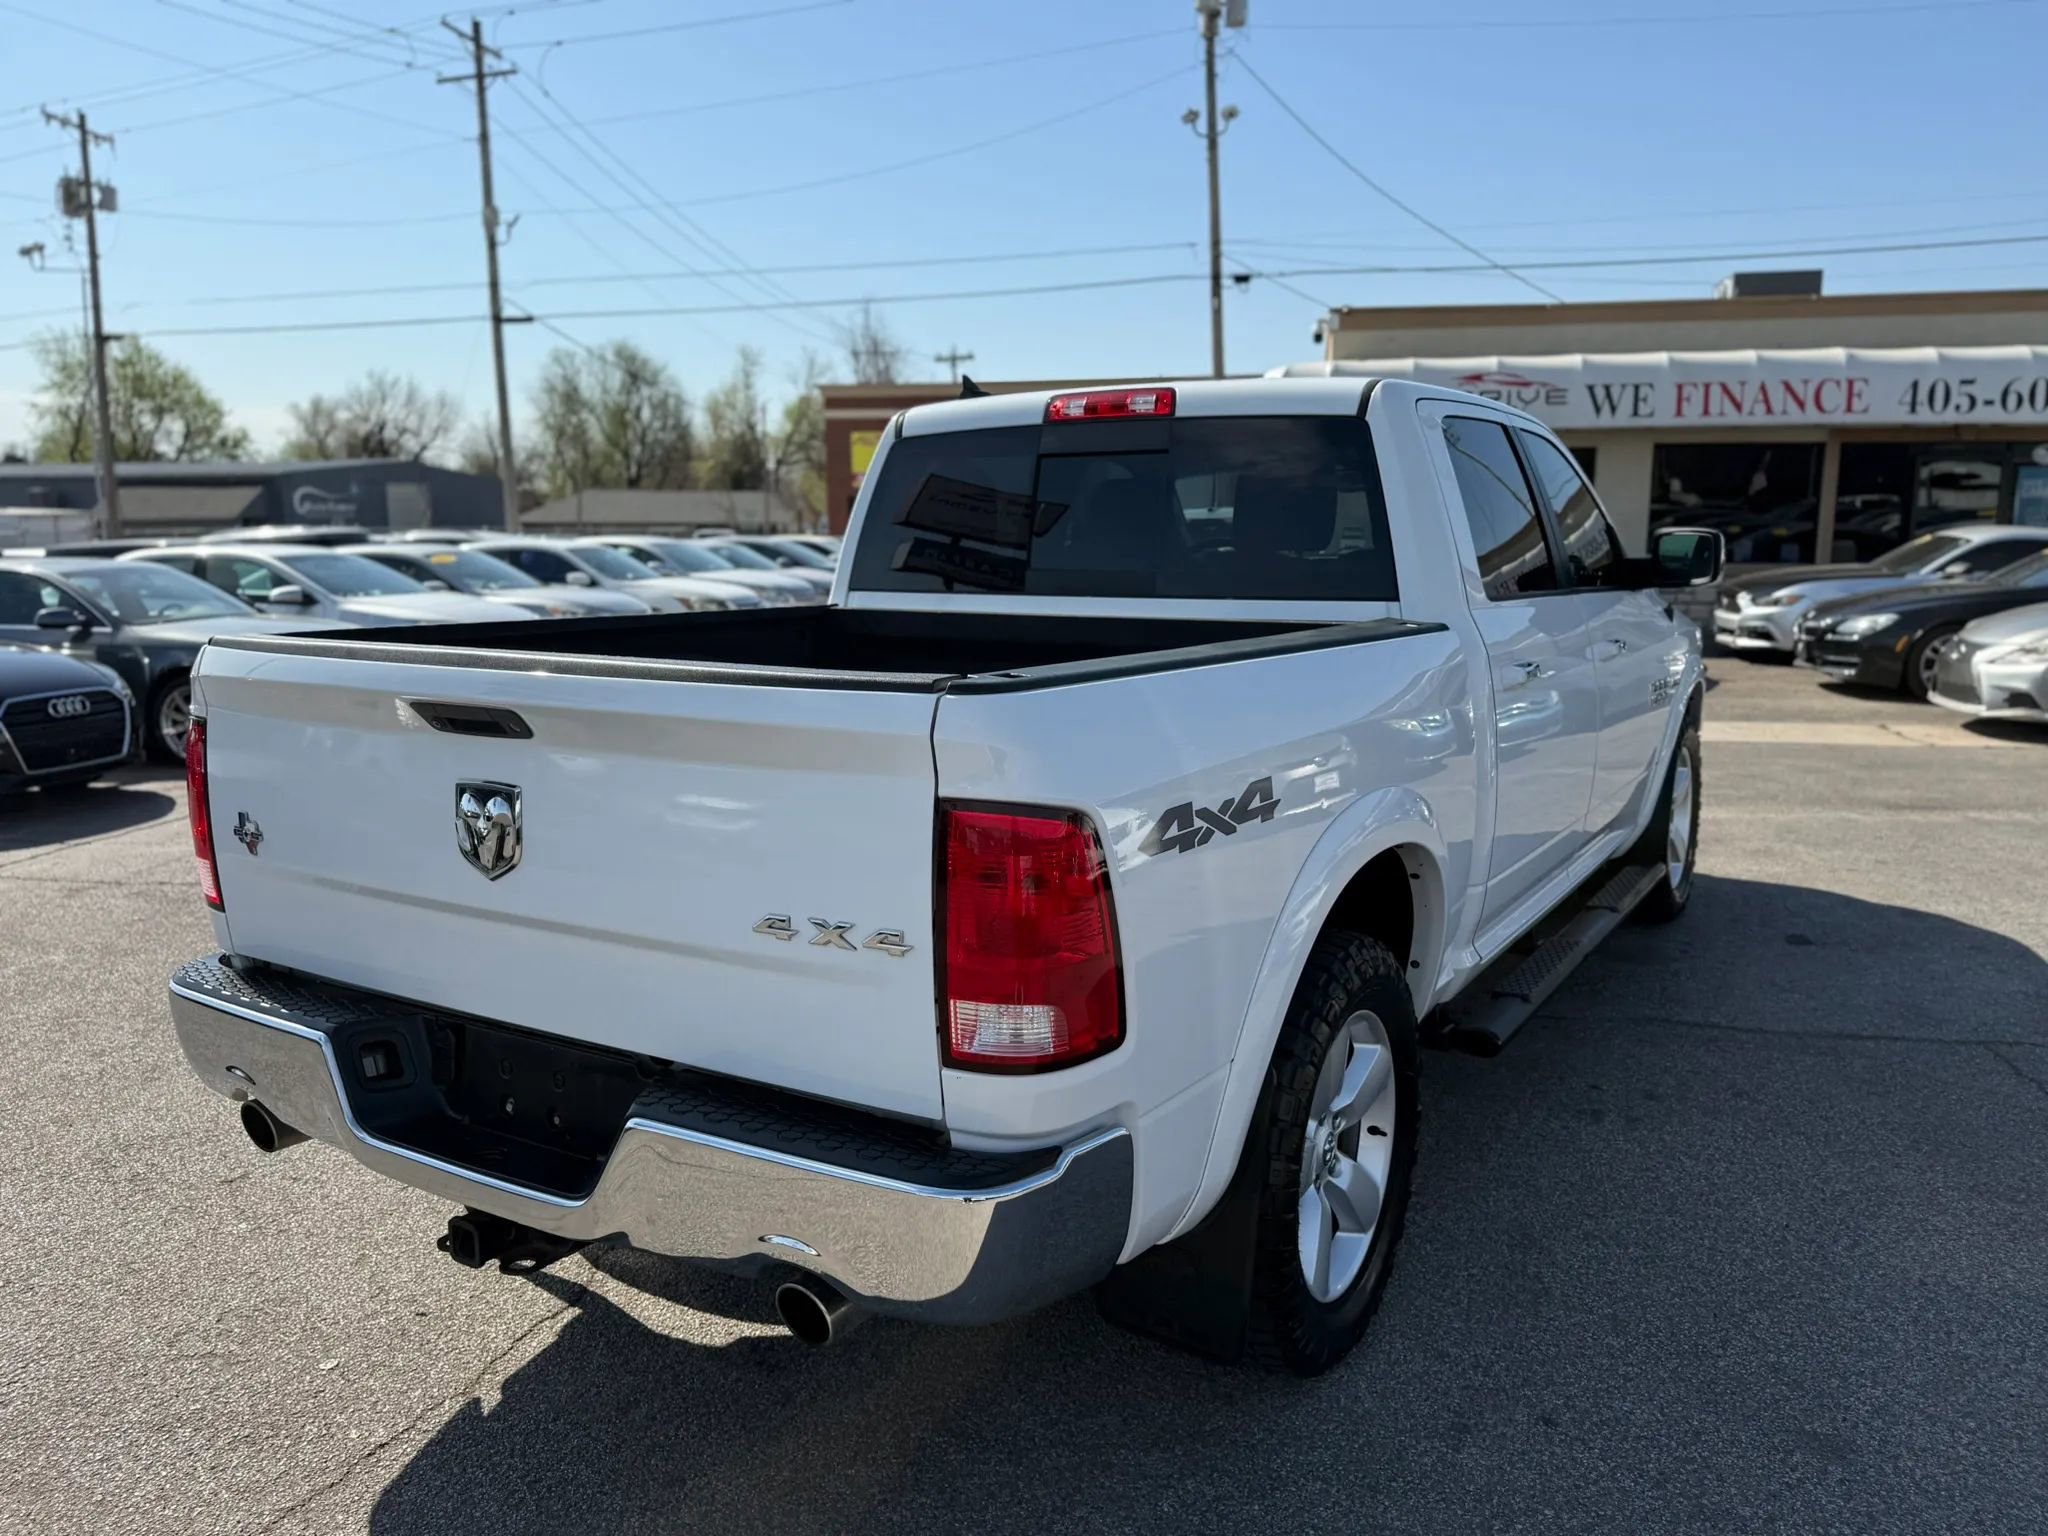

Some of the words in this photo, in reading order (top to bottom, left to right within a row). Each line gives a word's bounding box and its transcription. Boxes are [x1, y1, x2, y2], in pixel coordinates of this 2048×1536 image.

[1465, 388, 1569, 407] RIVE
[1586, 383, 1655, 418] WE
[1673, 378, 1870, 417] FINANCE
